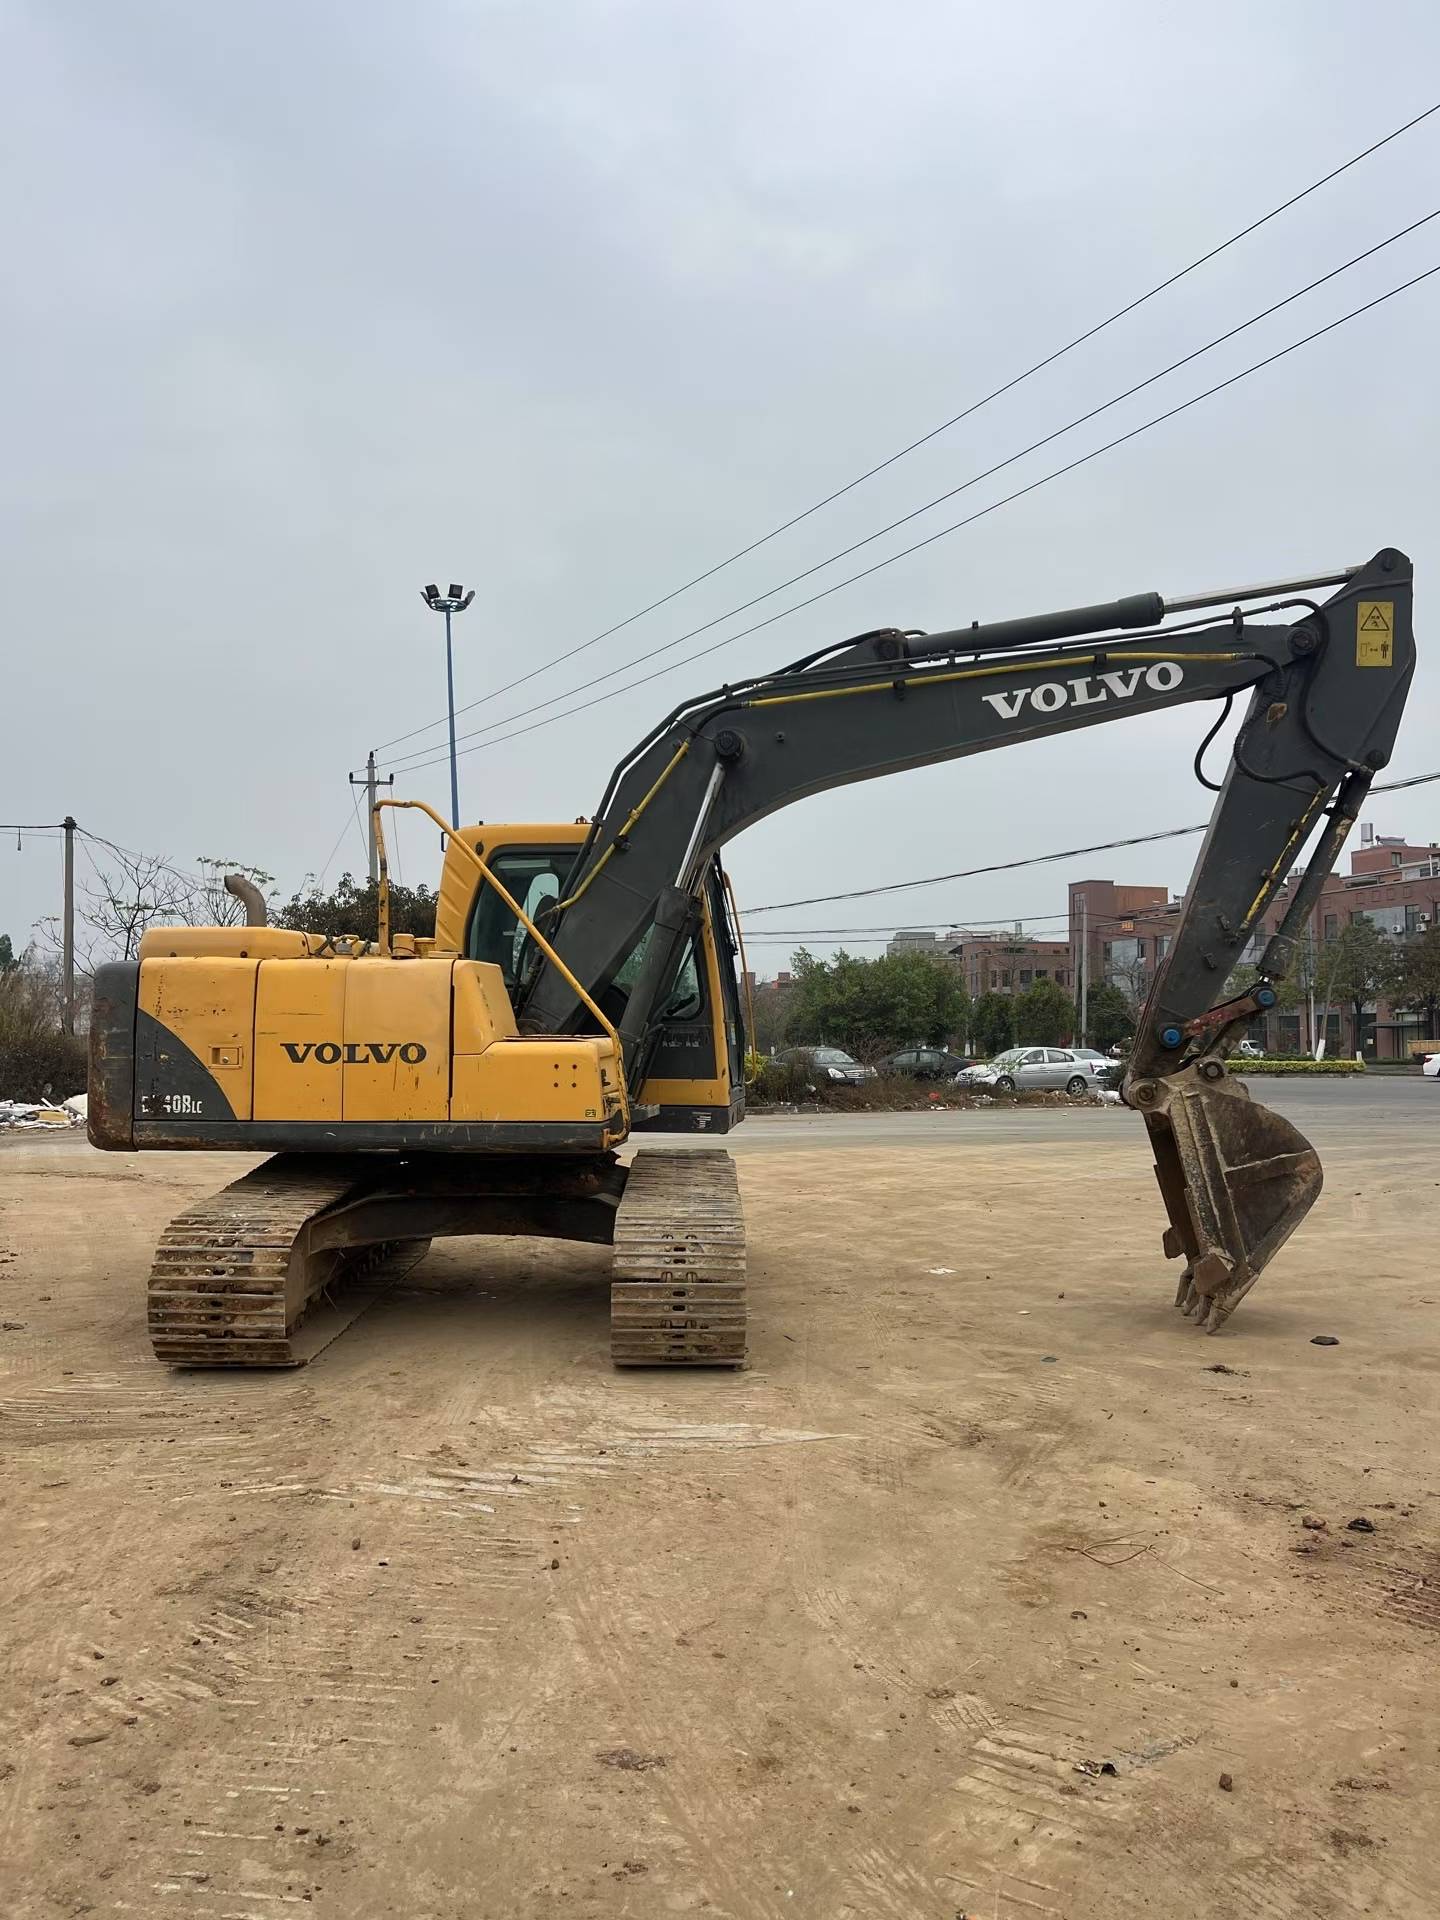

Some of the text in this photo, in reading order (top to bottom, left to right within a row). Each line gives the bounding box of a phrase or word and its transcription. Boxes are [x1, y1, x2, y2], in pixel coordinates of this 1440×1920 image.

[981, 661, 1184, 719] VOLVO
[280, 1042, 427, 1065] VOLVO
[141, 1094, 203, 1114] E40BLC
